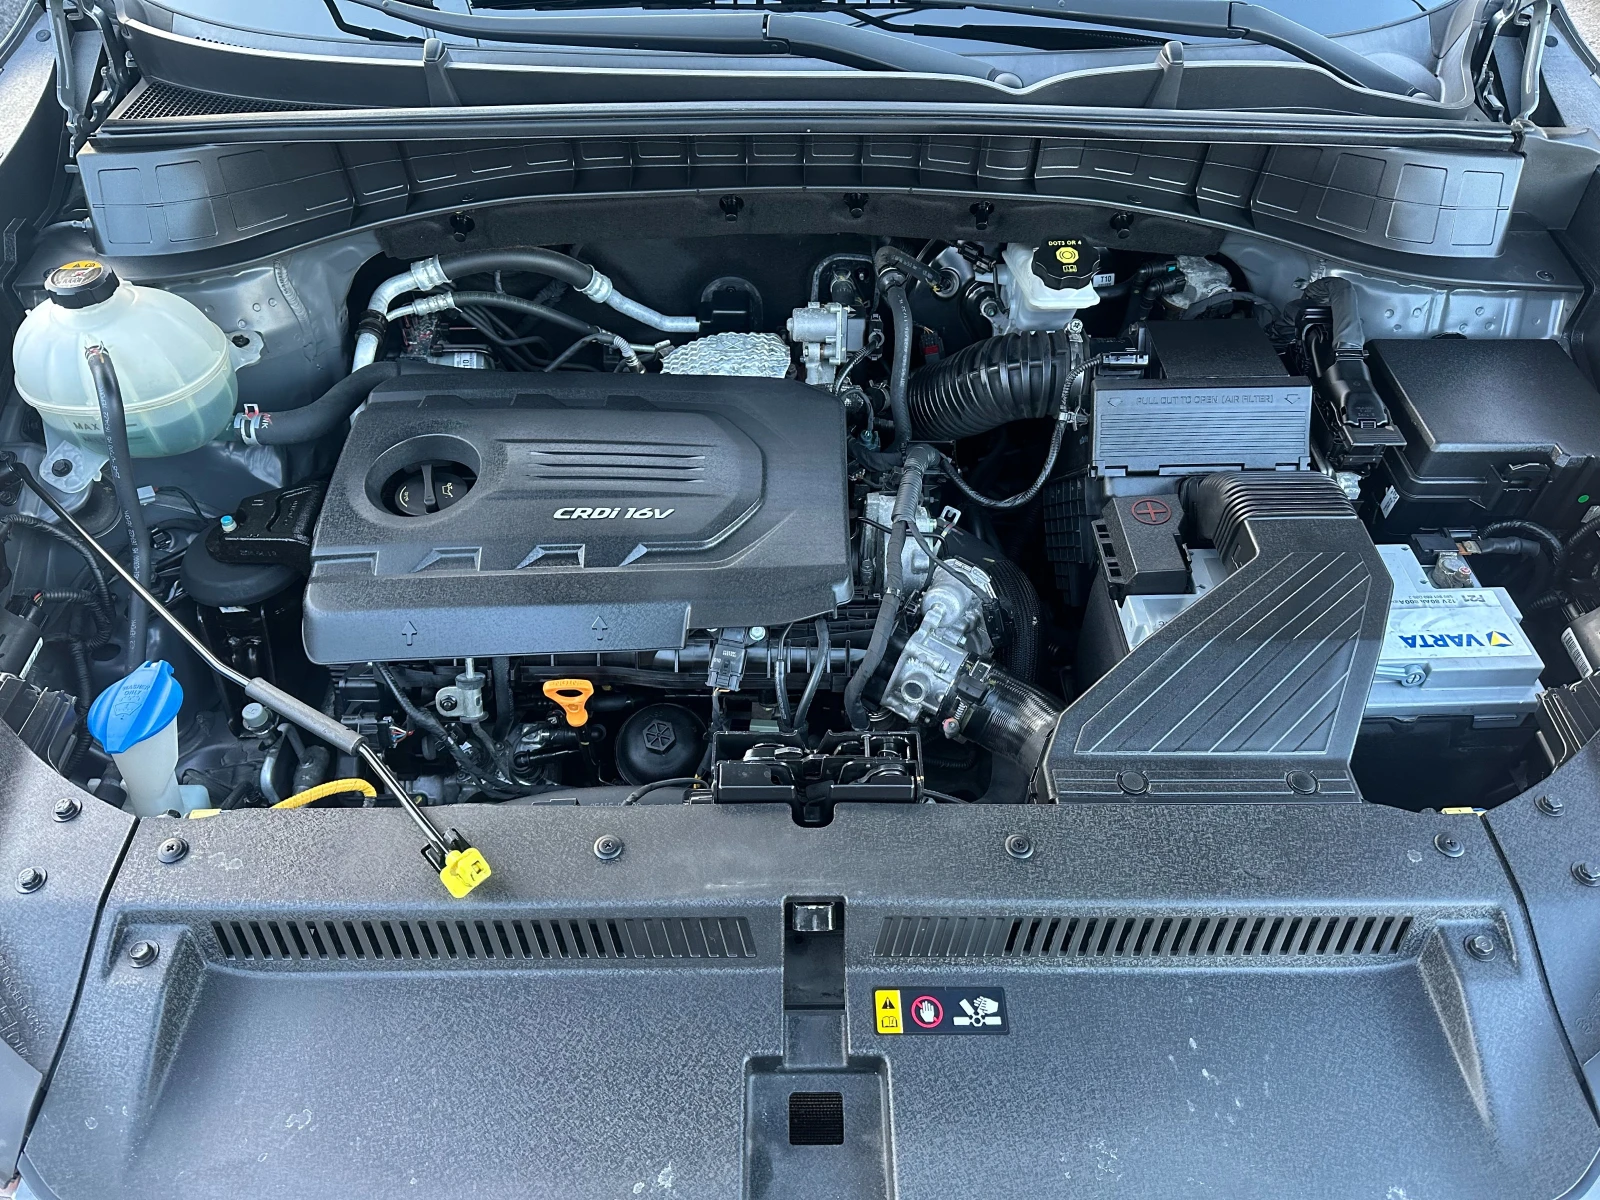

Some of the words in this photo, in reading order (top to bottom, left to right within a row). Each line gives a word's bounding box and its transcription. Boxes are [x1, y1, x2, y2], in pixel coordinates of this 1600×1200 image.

[1100, 275, 1112, 283] T10
[1136, 396, 1159, 405] PULL
[1160, 396, 1179, 405] OUT
[1180, 395, 1192, 404] TO
[1194, 395, 1218, 404] OPEN
[1221, 394, 1240, 404] (AIR
[1242, 394, 1274, 404] FILTER)
[73, 422, 100, 431] MAX
[553, 507, 621, 519] CRDi
[624, 507, 675, 519] 16V
[1398, 634, 1486, 648] VARTA
